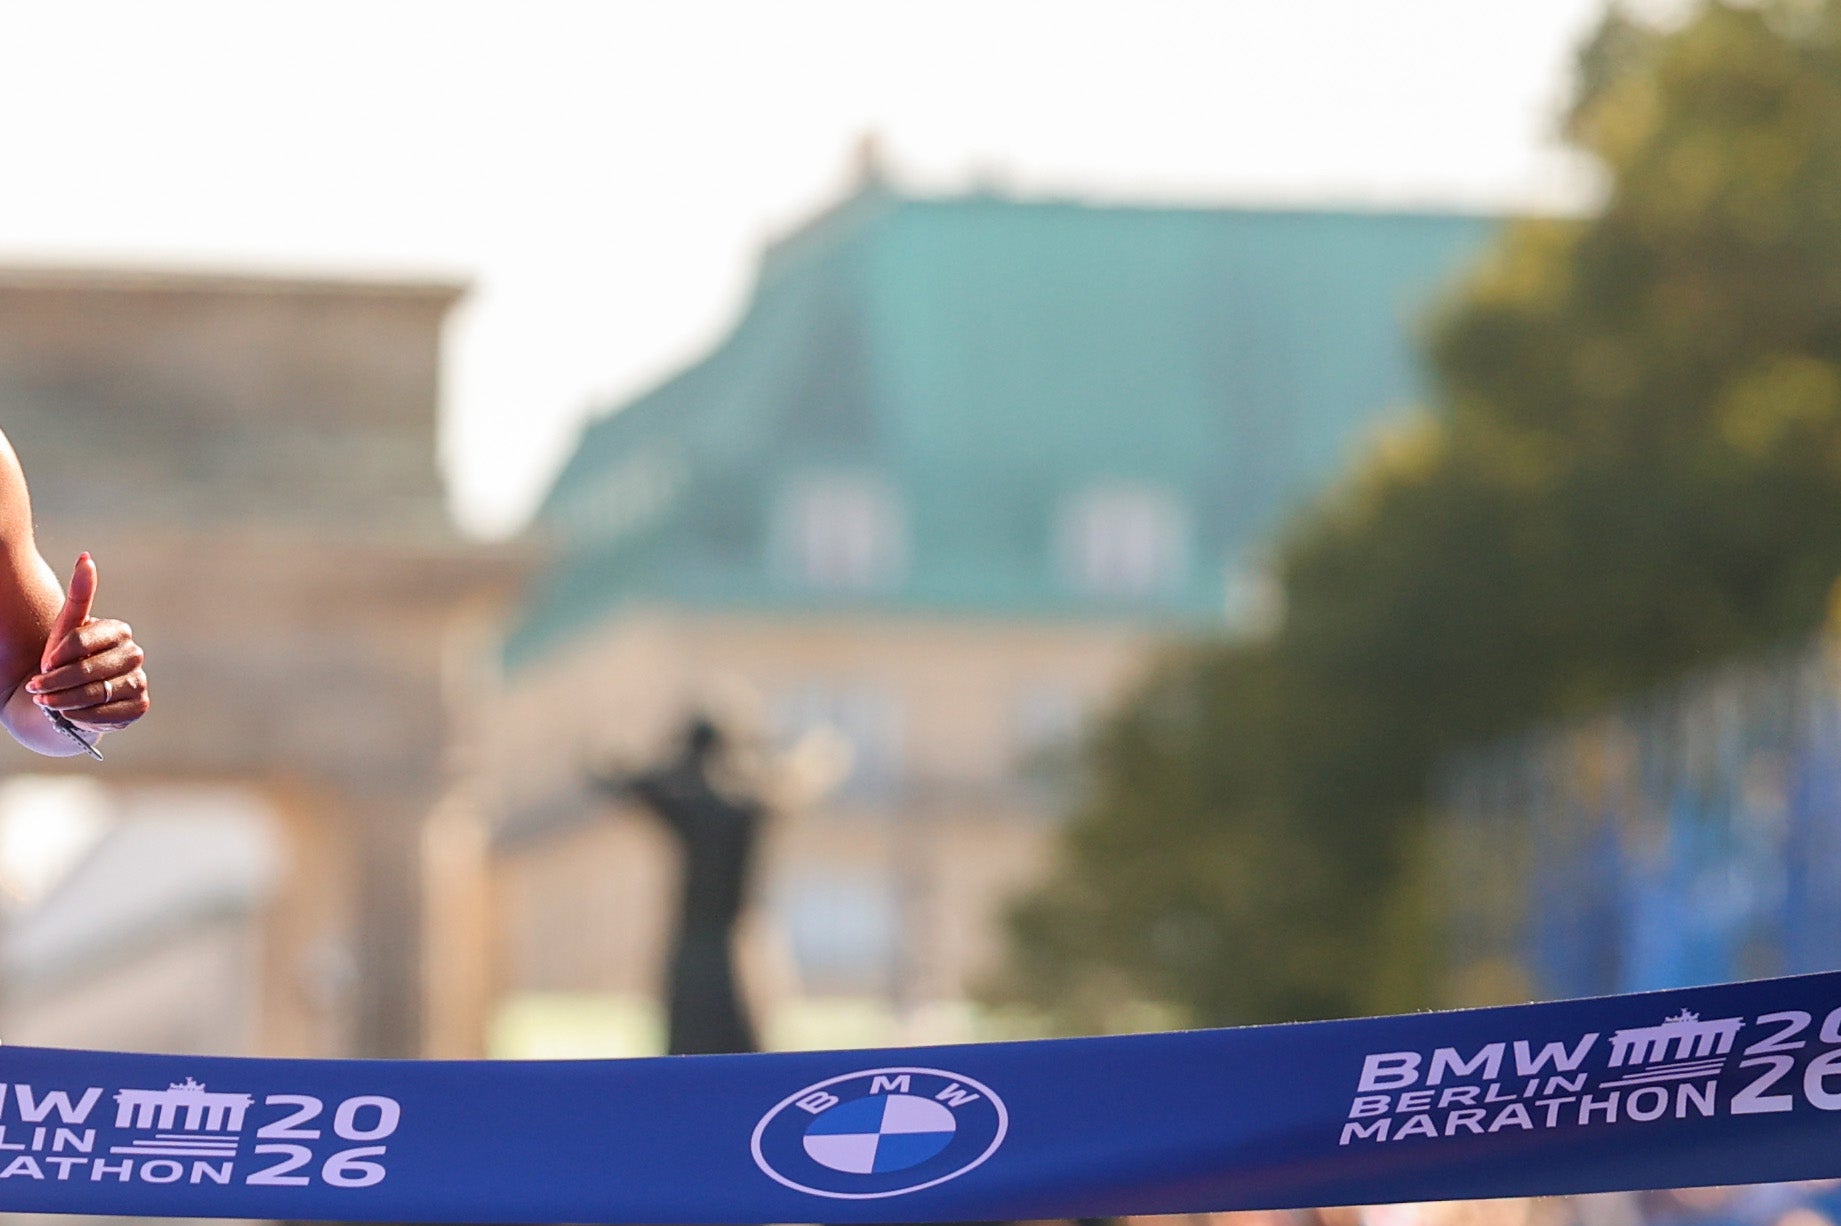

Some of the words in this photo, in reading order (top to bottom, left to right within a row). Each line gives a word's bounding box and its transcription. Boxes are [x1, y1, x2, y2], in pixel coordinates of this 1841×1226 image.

[1357, 1033, 1599, 1092] BMW
[1730, 1048, 1841, 1115] 26
[256, 1094, 401, 1141] 20
[795, 1074, 981, 1115] BMW
[1339, 1080, 1717, 1146] MARATHON
[1348, 1073, 1588, 1119] BERLIN
[245, 1144, 387, 1188] 26
